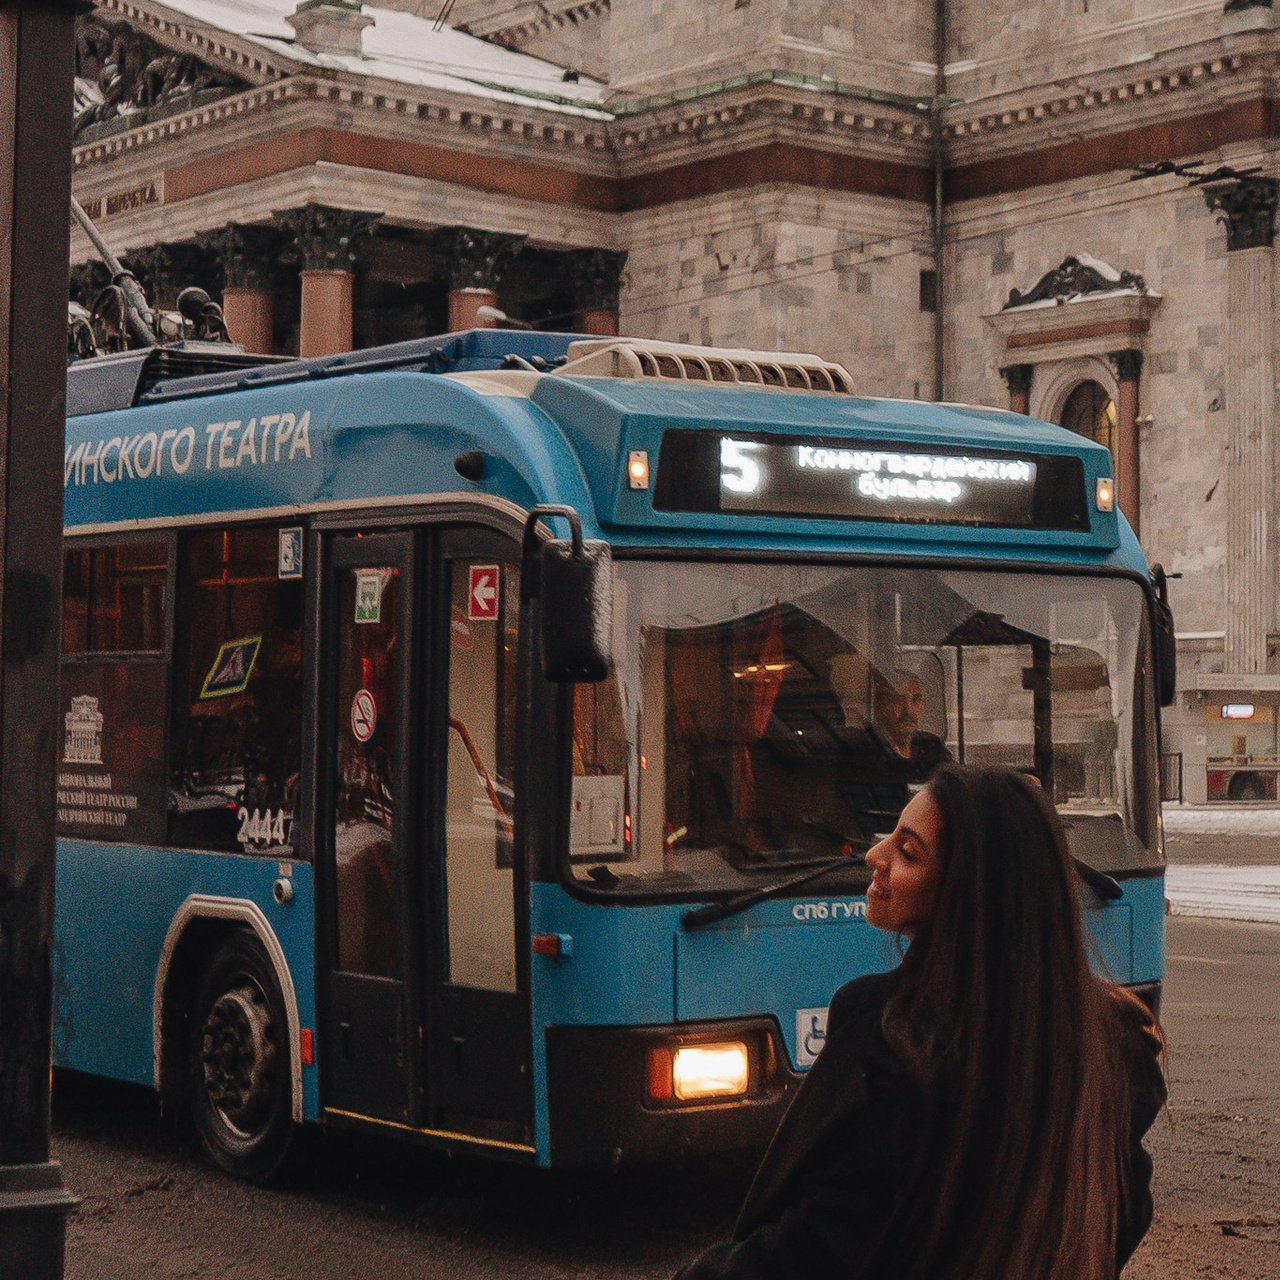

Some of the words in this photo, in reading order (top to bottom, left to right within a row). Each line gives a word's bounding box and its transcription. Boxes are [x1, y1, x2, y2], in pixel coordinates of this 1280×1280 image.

[205, 410, 312, 470] ТЕАТРА
[719, 436, 761, 493] 5
[797, 445, 1030, 482] Конногвардейский
[858, 471, 961, 503] бульвар
[237, 806, 285, 845] 2444
